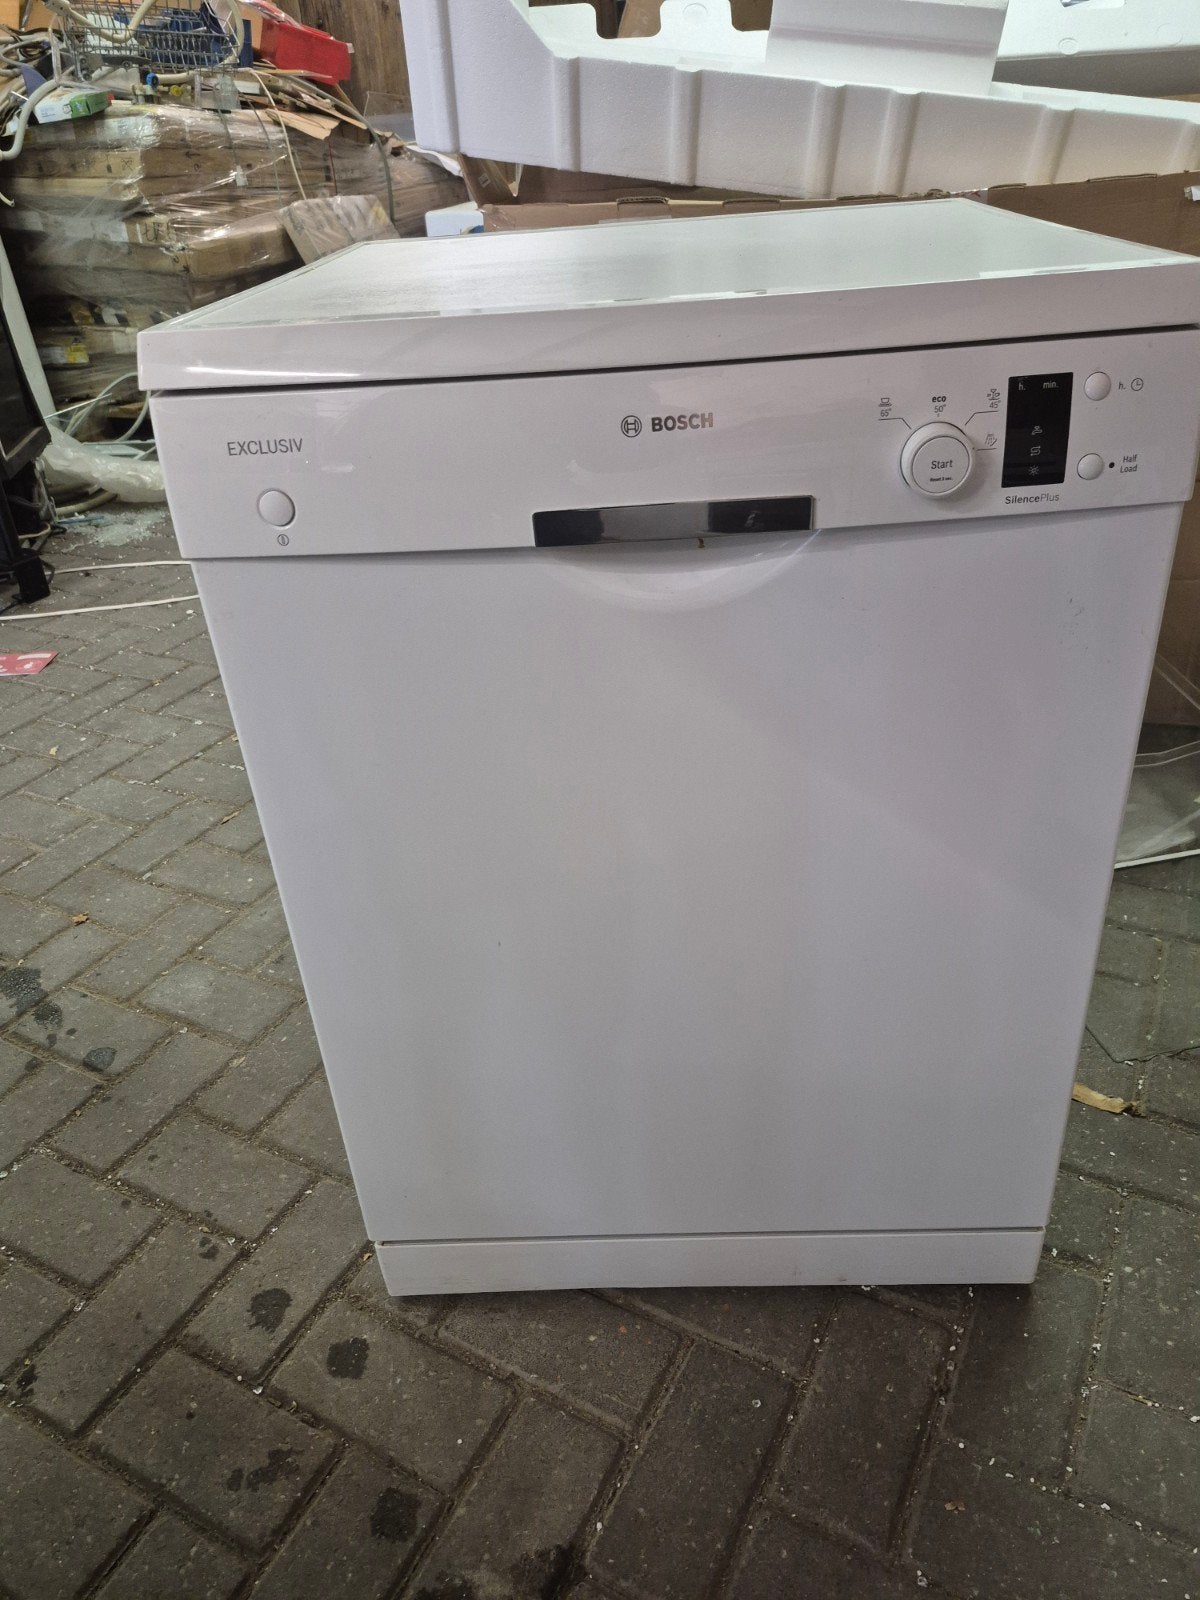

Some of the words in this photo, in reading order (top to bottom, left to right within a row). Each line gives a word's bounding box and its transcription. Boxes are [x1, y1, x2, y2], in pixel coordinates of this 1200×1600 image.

[1043, 380, 1059, 389] min.
[1118, 381, 1126, 390] h.
[932, 395, 947, 403] eco
[651, 412, 714, 432] BOSCH
[227, 438, 303, 456] EXCLUSIV
[1122, 454, 1138, 463] Half
[930, 459, 953, 470] Start
[1120, 464, 1138, 474] Load
[1004, 493, 1060, 505] SilencePlus
